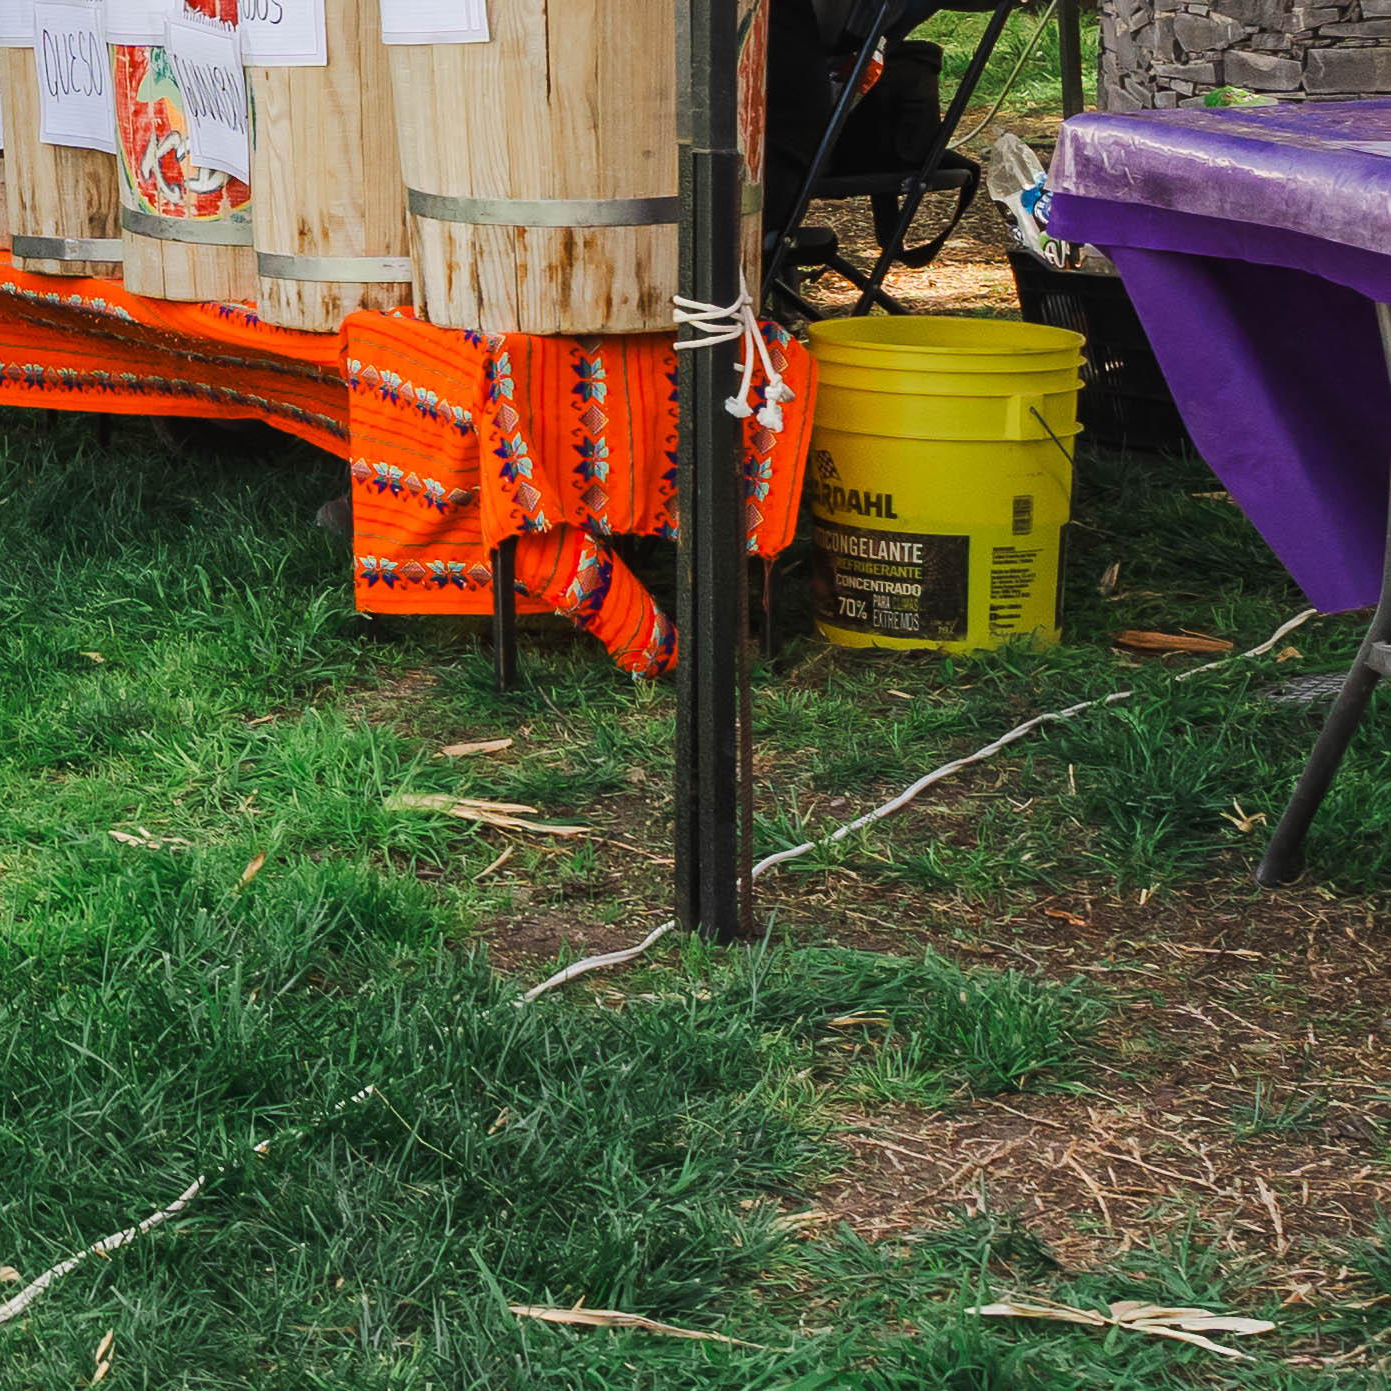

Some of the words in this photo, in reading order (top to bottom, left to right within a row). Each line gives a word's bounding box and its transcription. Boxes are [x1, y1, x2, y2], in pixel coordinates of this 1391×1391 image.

[43, 29, 103, 104] QUESO
[818, 484, 899, 519] RDAHL
[836, 573, 922, 596] CONCENTRADO
[837, 596, 868, 620] 70%
